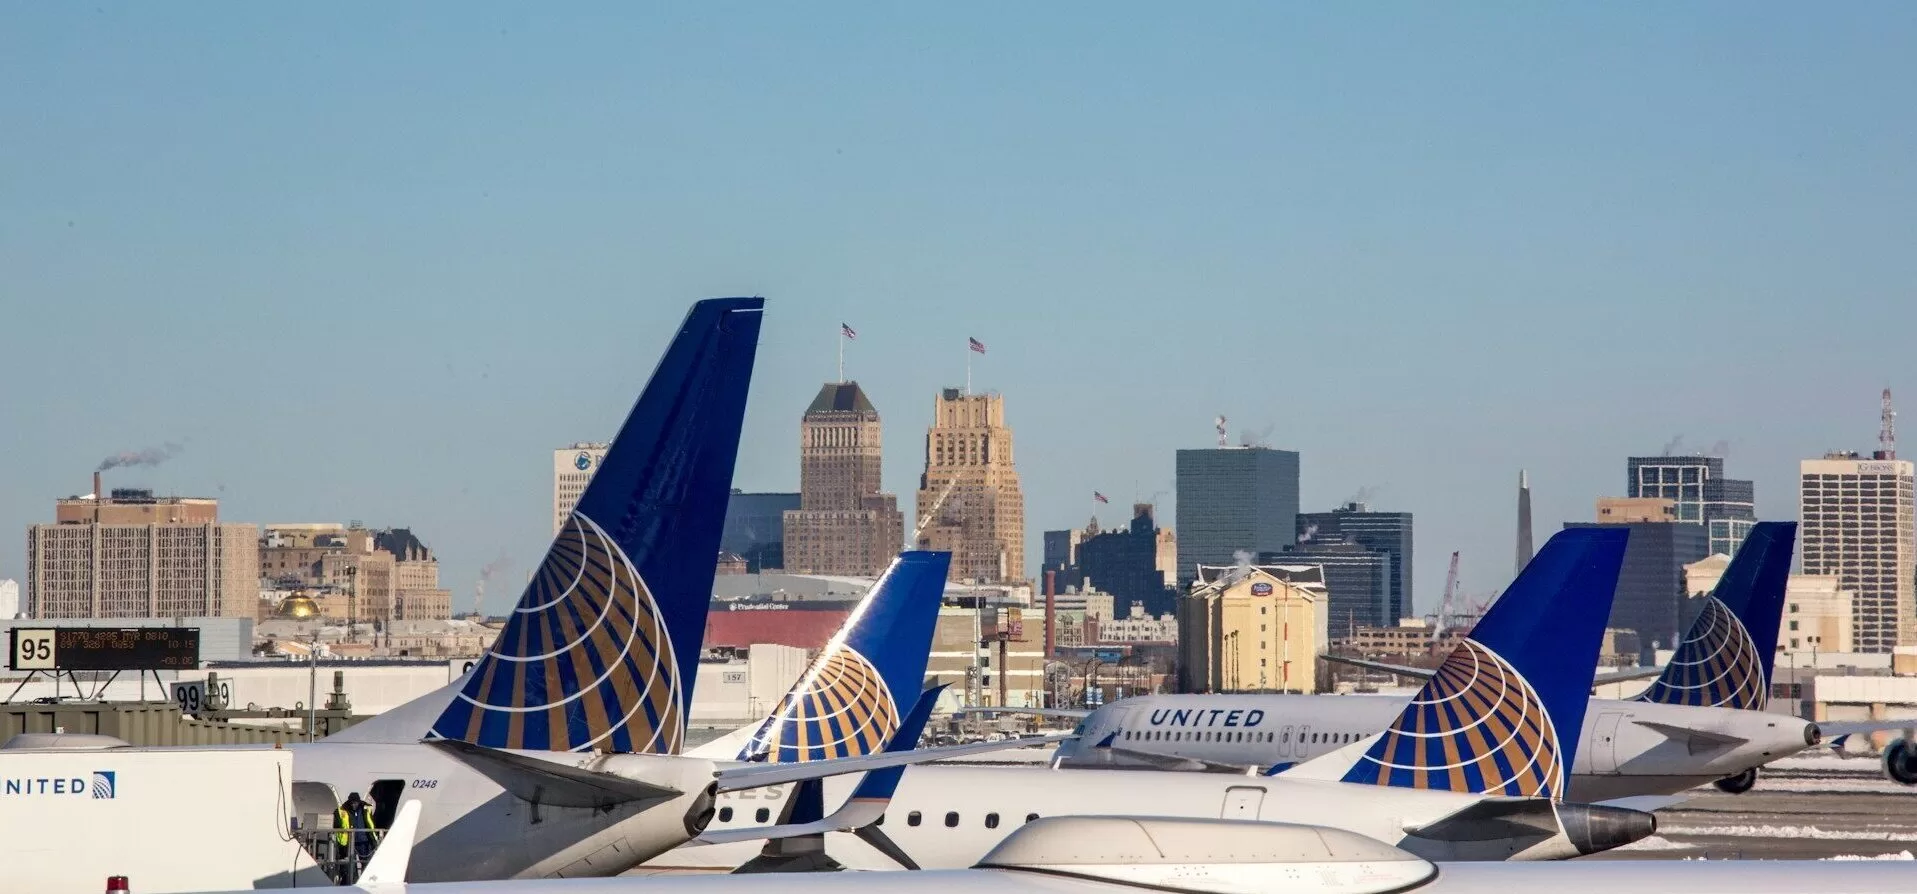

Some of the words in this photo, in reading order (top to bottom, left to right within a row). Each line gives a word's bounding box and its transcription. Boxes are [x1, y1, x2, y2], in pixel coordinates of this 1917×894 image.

[22, 638, 50, 660] 95
[177, 685, 199, 711] 99
[1150, 709, 1265, 727] UNITED
[0, 778, 85, 794] NITED
[412, 779, 438, 789] 0248
